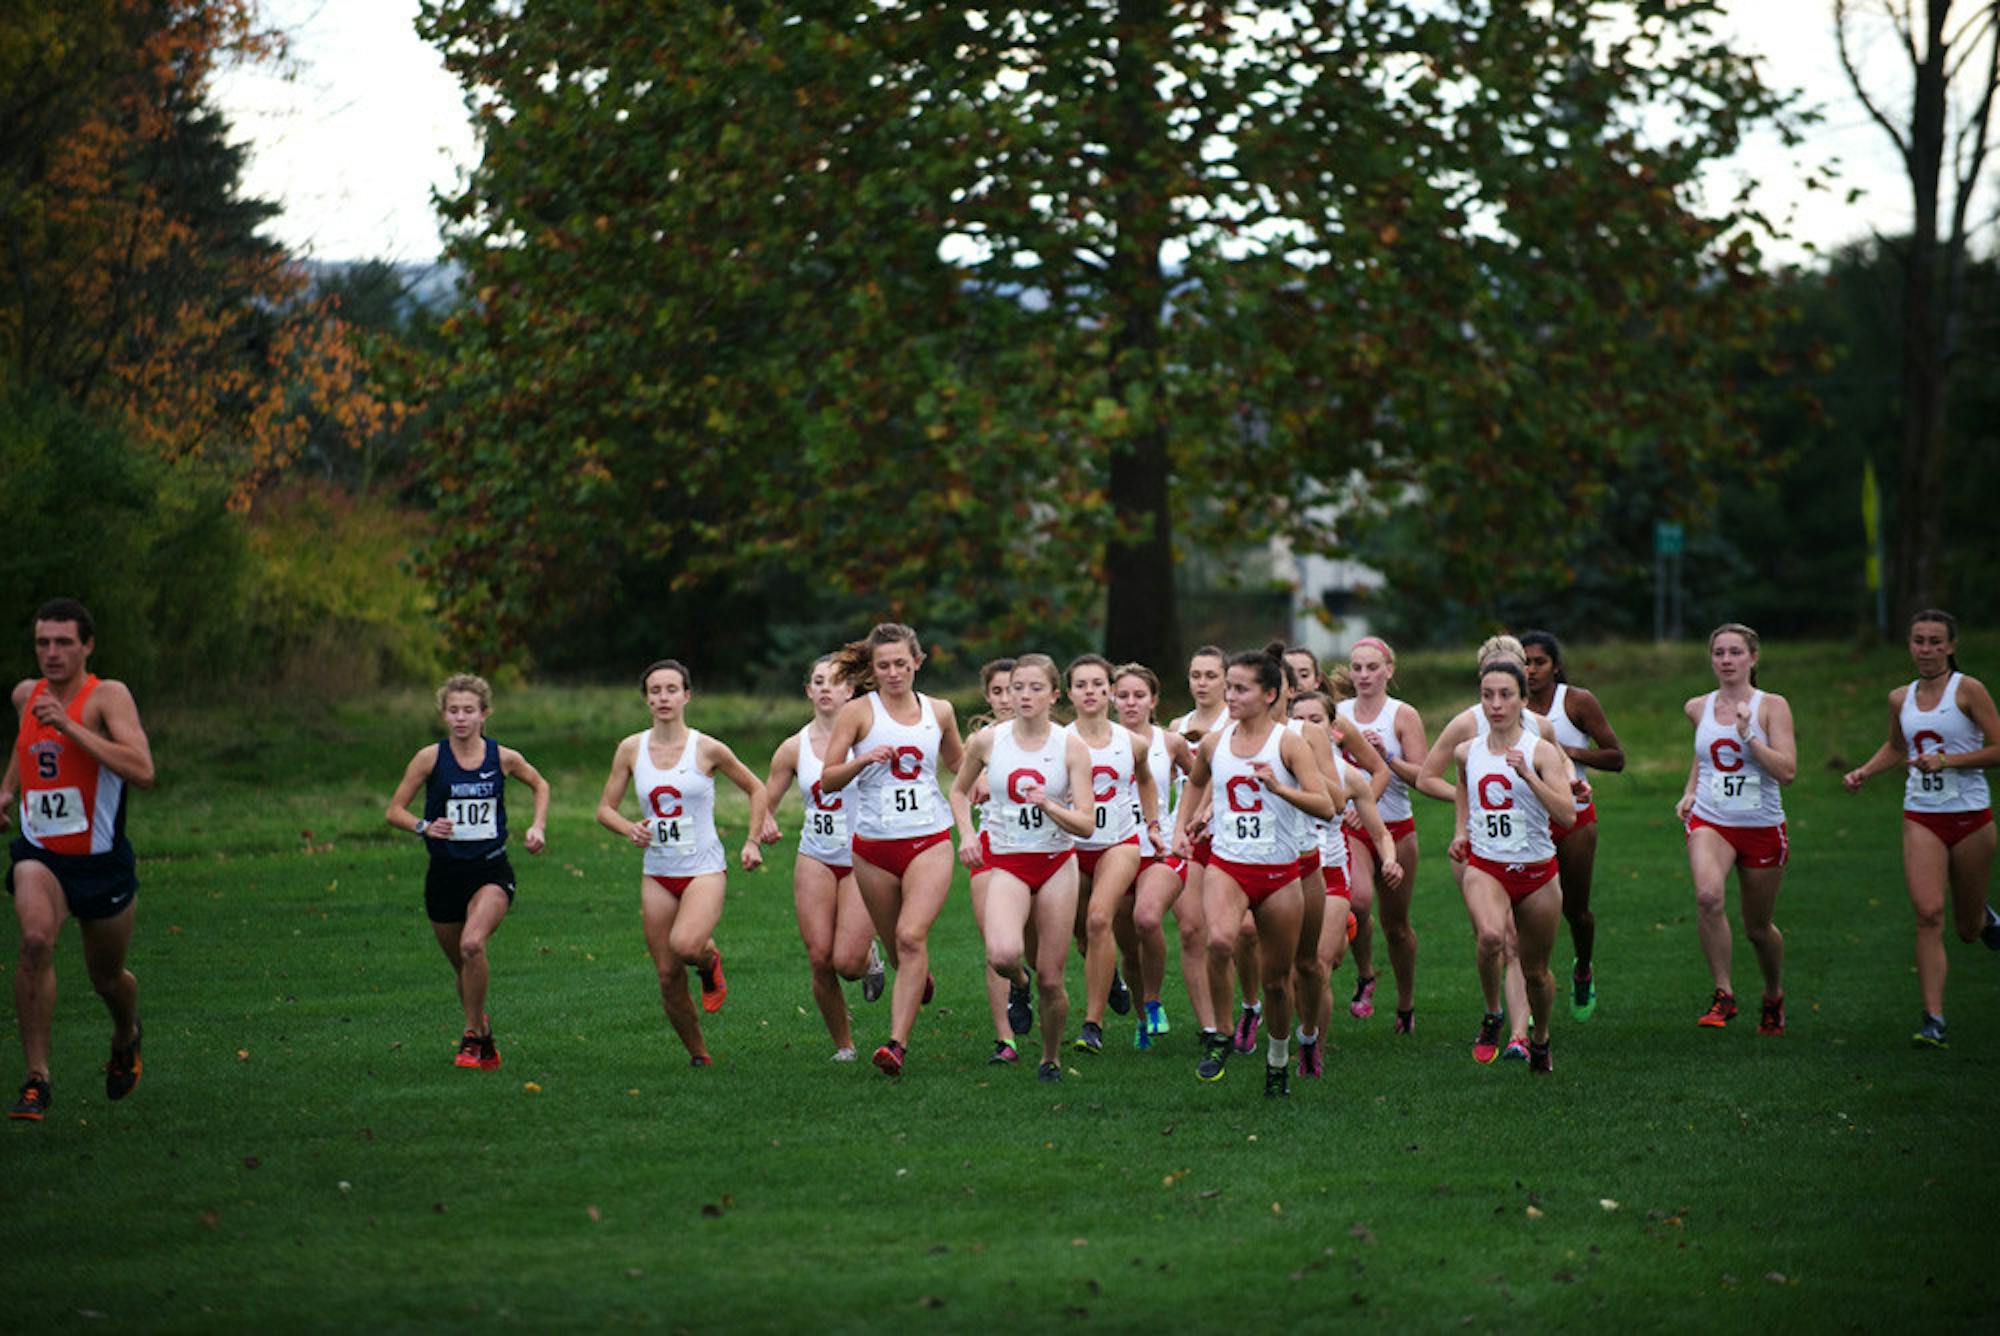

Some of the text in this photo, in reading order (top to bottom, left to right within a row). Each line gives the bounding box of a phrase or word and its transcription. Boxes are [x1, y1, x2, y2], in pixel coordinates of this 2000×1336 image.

[38, 751, 58, 779] S
[891, 746, 924, 780] C
[1710, 738, 1744, 772] C
[450, 783, 495, 797] MIDWEST
[1008, 768, 1045, 804] C
[1478, 773, 1513, 810] C
[1724, 775, 1746, 796] 57
[1922, 768, 1944, 791] 65
[648, 785, 682, 818] C
[895, 788, 918, 812] 51
[1226, 775, 1262, 812] C
[42, 793, 69, 819] 42
[456, 802, 489, 825] 102
[1018, 806, 1042, 830] 49
[1095, 806, 1106, 828] 0
[658, 820, 680, 843] 64
[814, 814, 834, 835] 58
[1236, 816, 1261, 839] 63
[1486, 814, 1511, 838] 56
